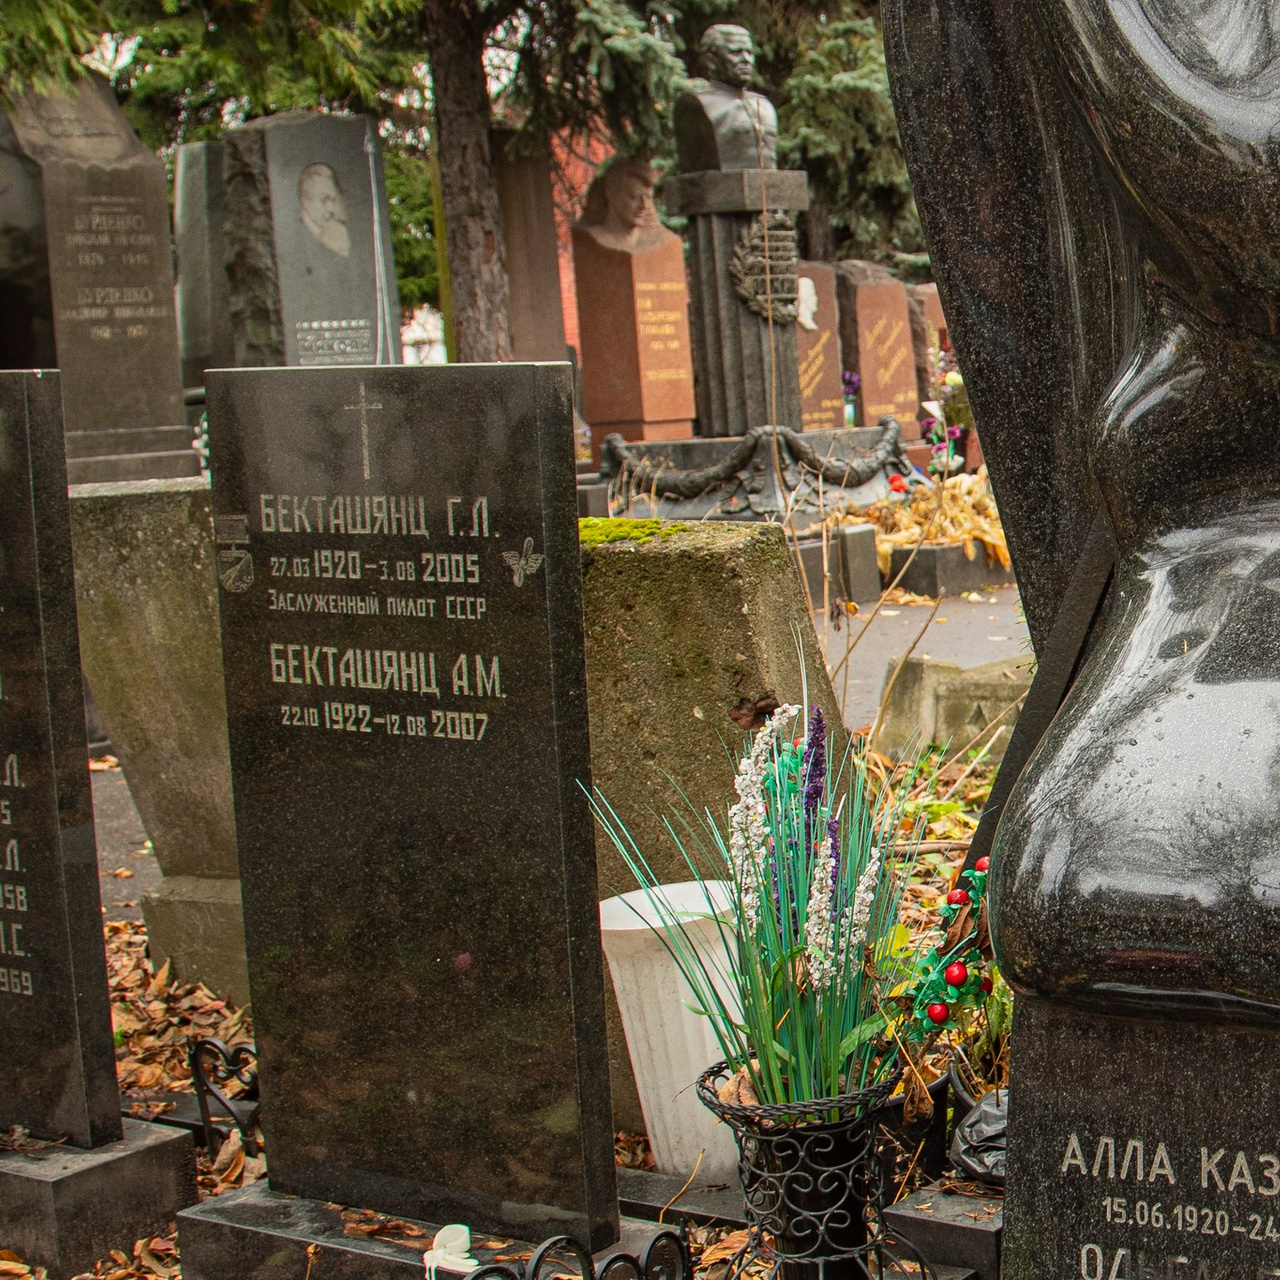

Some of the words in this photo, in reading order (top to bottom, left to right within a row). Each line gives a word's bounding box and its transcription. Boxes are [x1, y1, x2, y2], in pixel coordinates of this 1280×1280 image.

[259, 493, 430, 540] БЕКТАШЯНЦ
[447, 495, 500, 538] Г.Л.
[270, 556, 311, 577] 27.03
[421, 553, 480, 583] 2005
[446, 595, 487, 620] СССР
[270, 643, 440, 700] БЕКТАШЯНЦ
[452, 652, 508, 698] А.М.
[431, 710, 489, 741] 2007
[1061, 1132, 1176, 1185] АЛЛА
